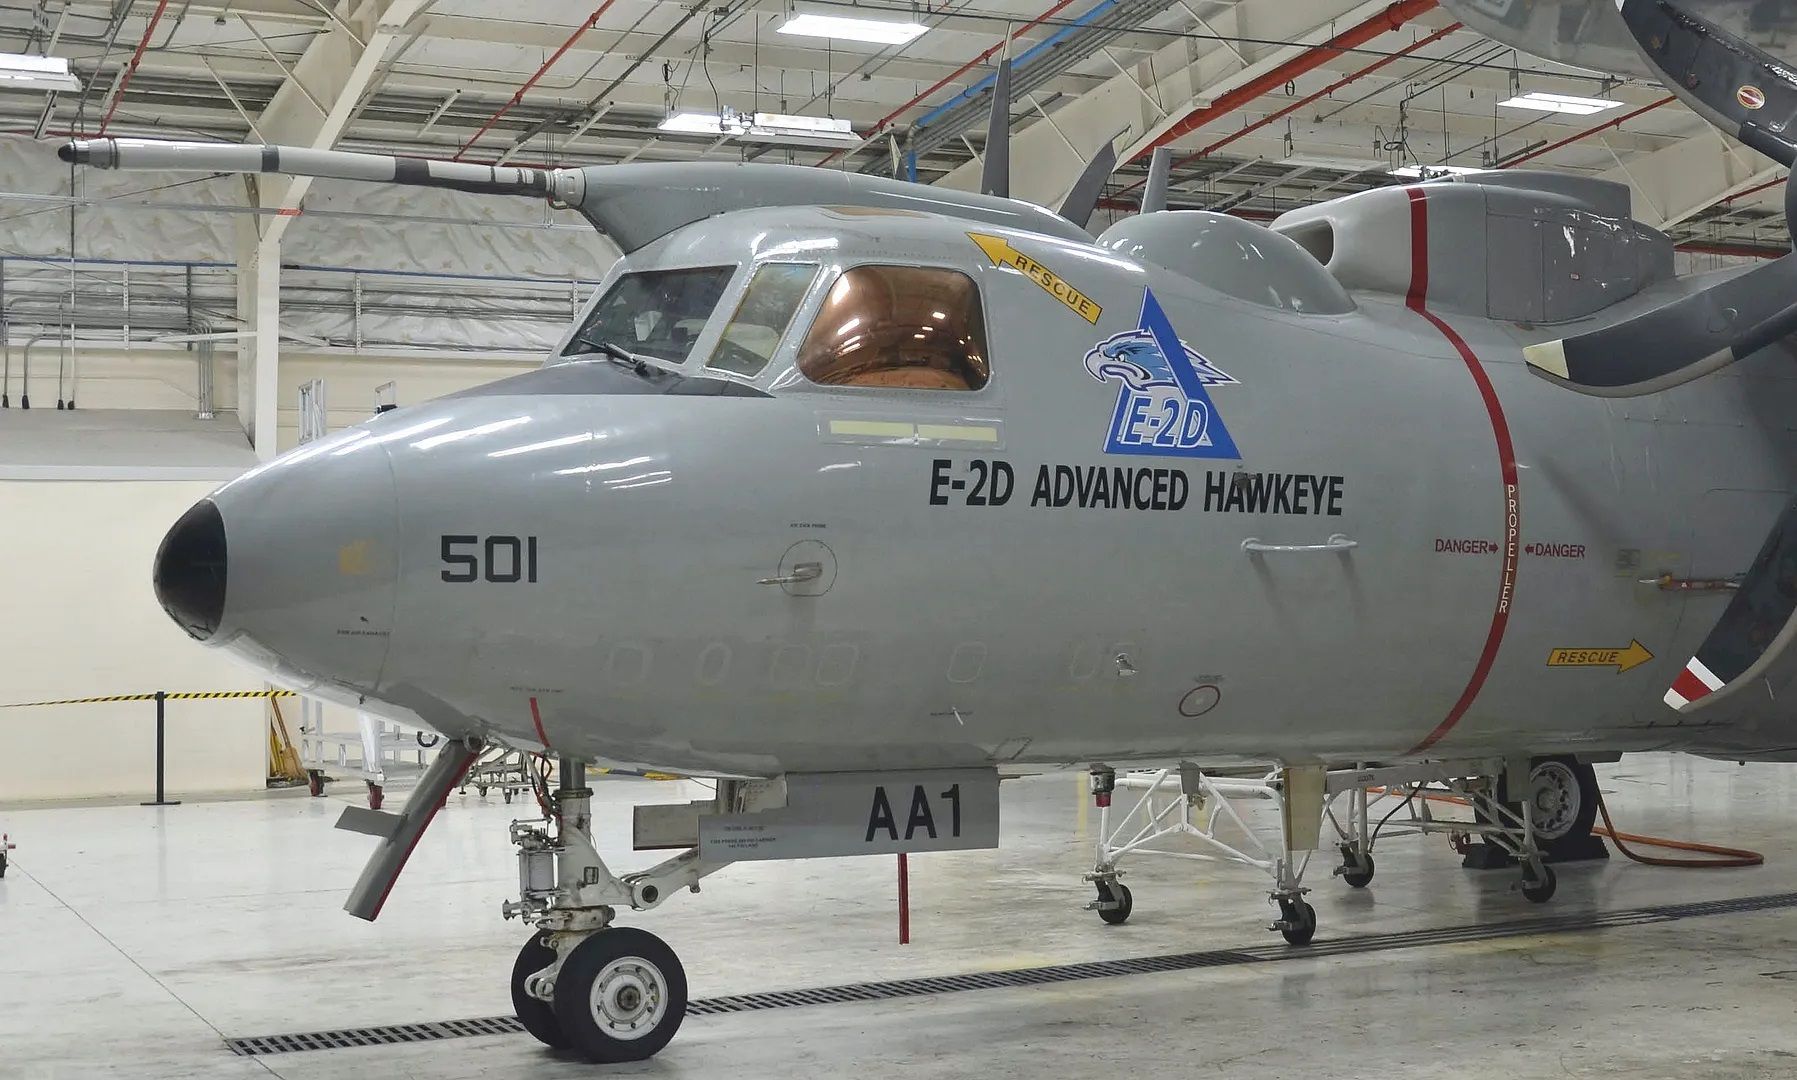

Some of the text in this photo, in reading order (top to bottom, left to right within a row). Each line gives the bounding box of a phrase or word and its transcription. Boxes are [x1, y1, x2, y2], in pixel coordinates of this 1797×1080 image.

[1016, 256, 1091, 314] RESCUE
[1120, 396, 1208, 448] E-2D
[929, 458, 1345, 516] E-2D ADVANCED HAWKEYE
[440, 534, 538, 584] 501
[1435, 538, 1489, 554] DANGER
[1498, 484, 1518, 614] PROPELLER
[1534, 543, 1586, 559] DANGER
[1556, 651, 1620, 663] RESCUE
[865, 782, 962, 843] AA1
